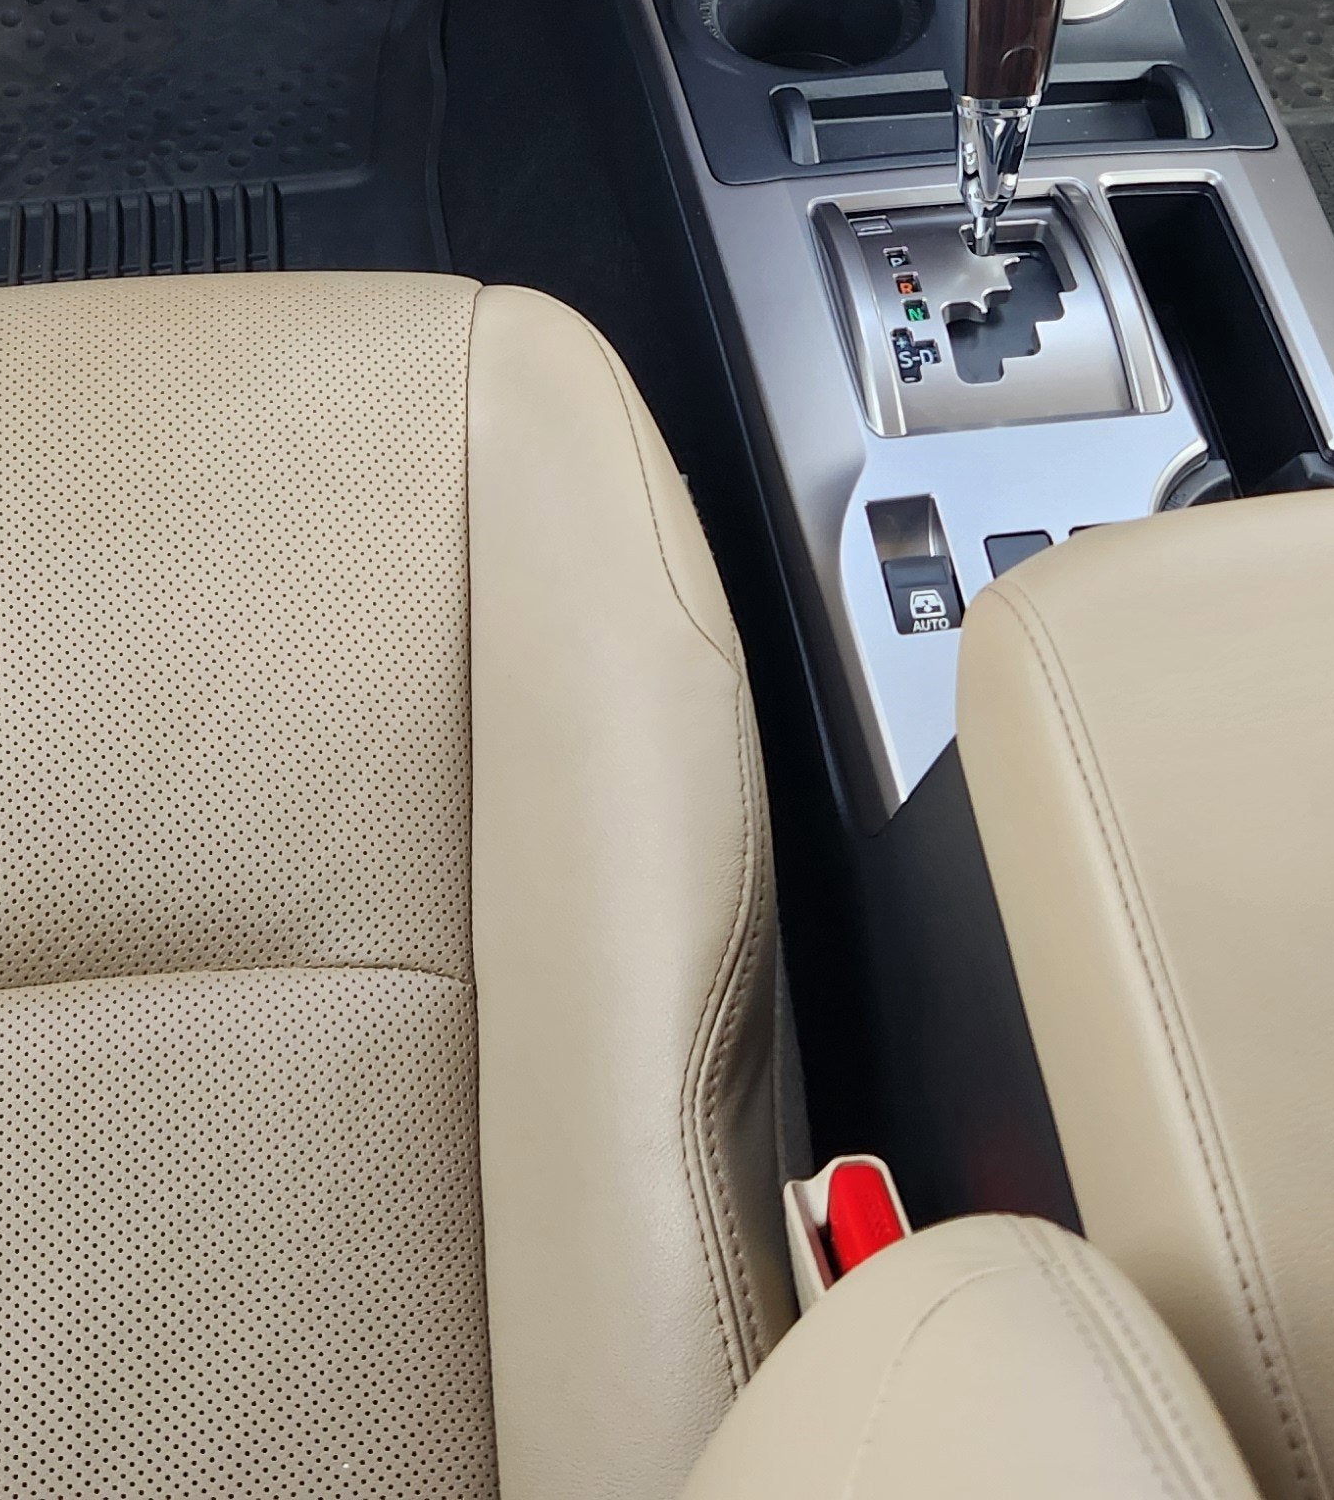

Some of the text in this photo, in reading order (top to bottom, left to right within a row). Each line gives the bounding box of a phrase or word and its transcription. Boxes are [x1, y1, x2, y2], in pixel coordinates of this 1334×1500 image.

[899, 282, 913, 294] R
[908, 308, 924, 320] N
[913, 618, 950, 633] AUTO
